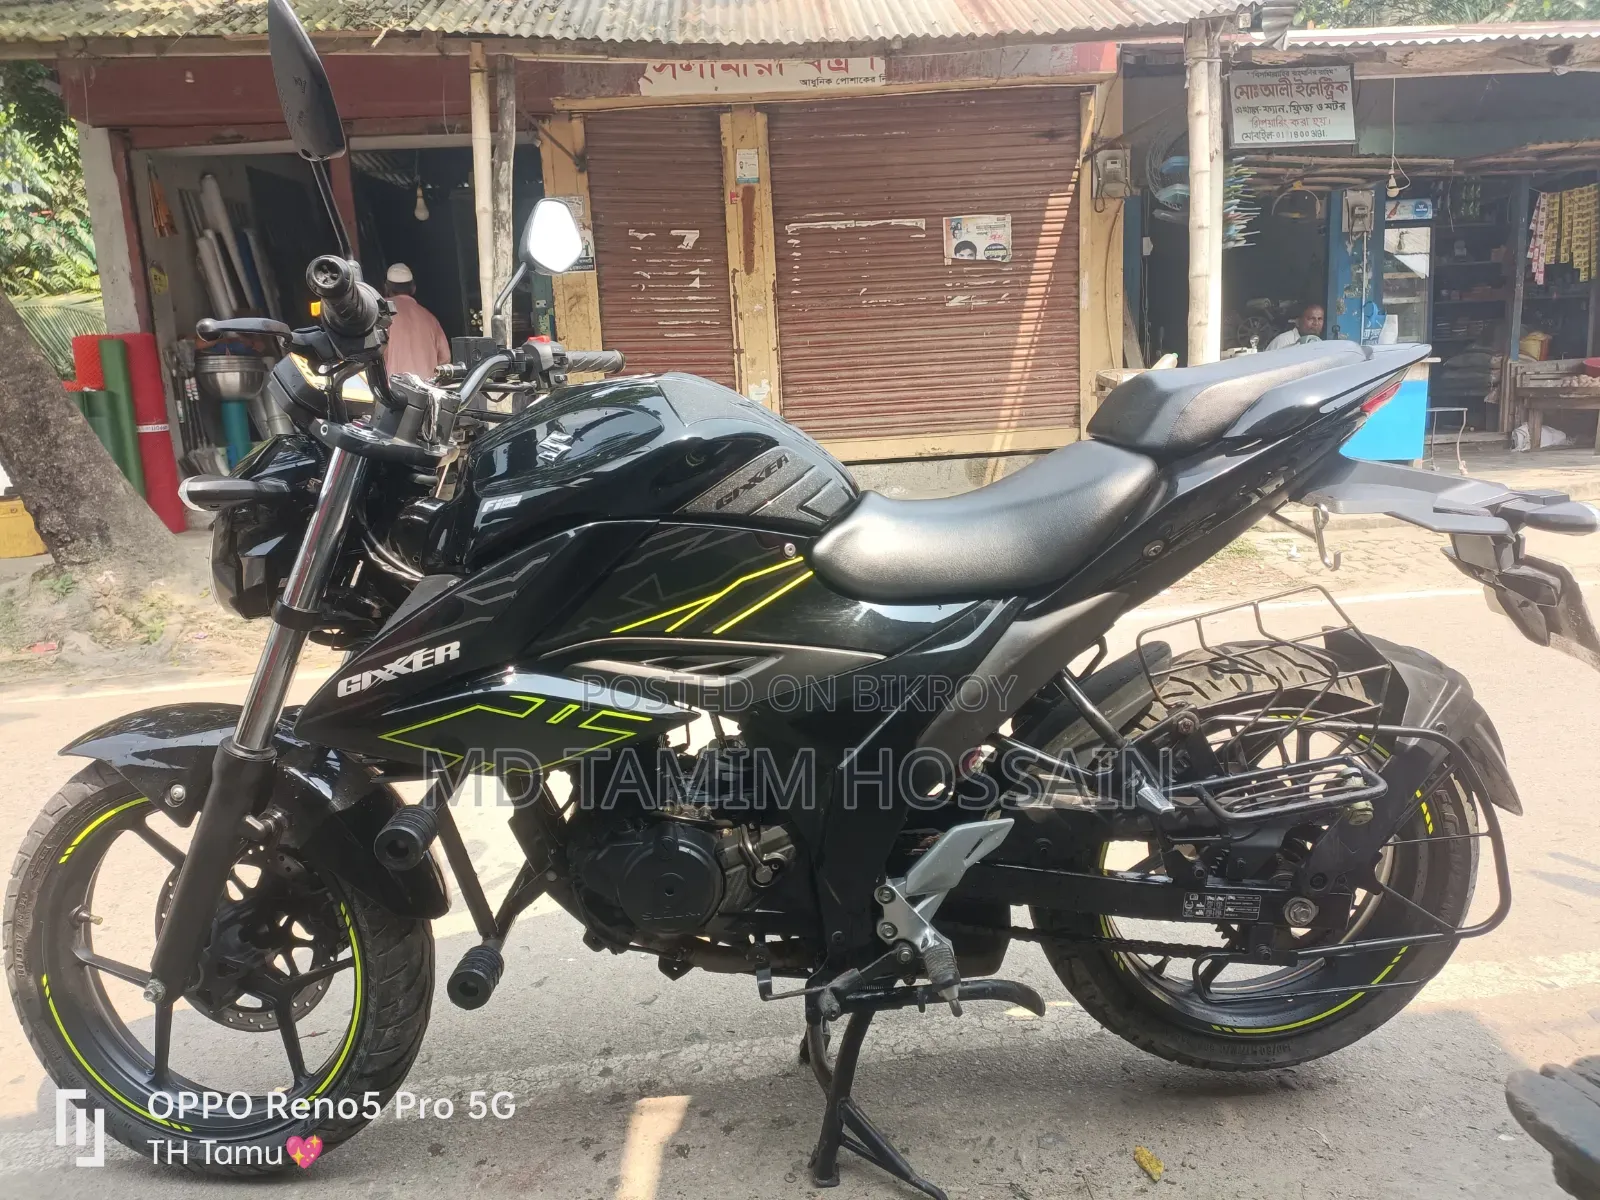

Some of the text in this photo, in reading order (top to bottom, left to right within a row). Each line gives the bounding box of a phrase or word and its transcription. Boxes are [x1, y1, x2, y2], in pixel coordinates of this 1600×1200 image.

[799, 77, 832, 88] আধুনিক
[836, 75, 876, 86] পোশাকের
[1324, 101, 1346, 111] মটর
[716, 454, 789, 510] GIXXER
[337, 641, 461, 698] GIXXER
